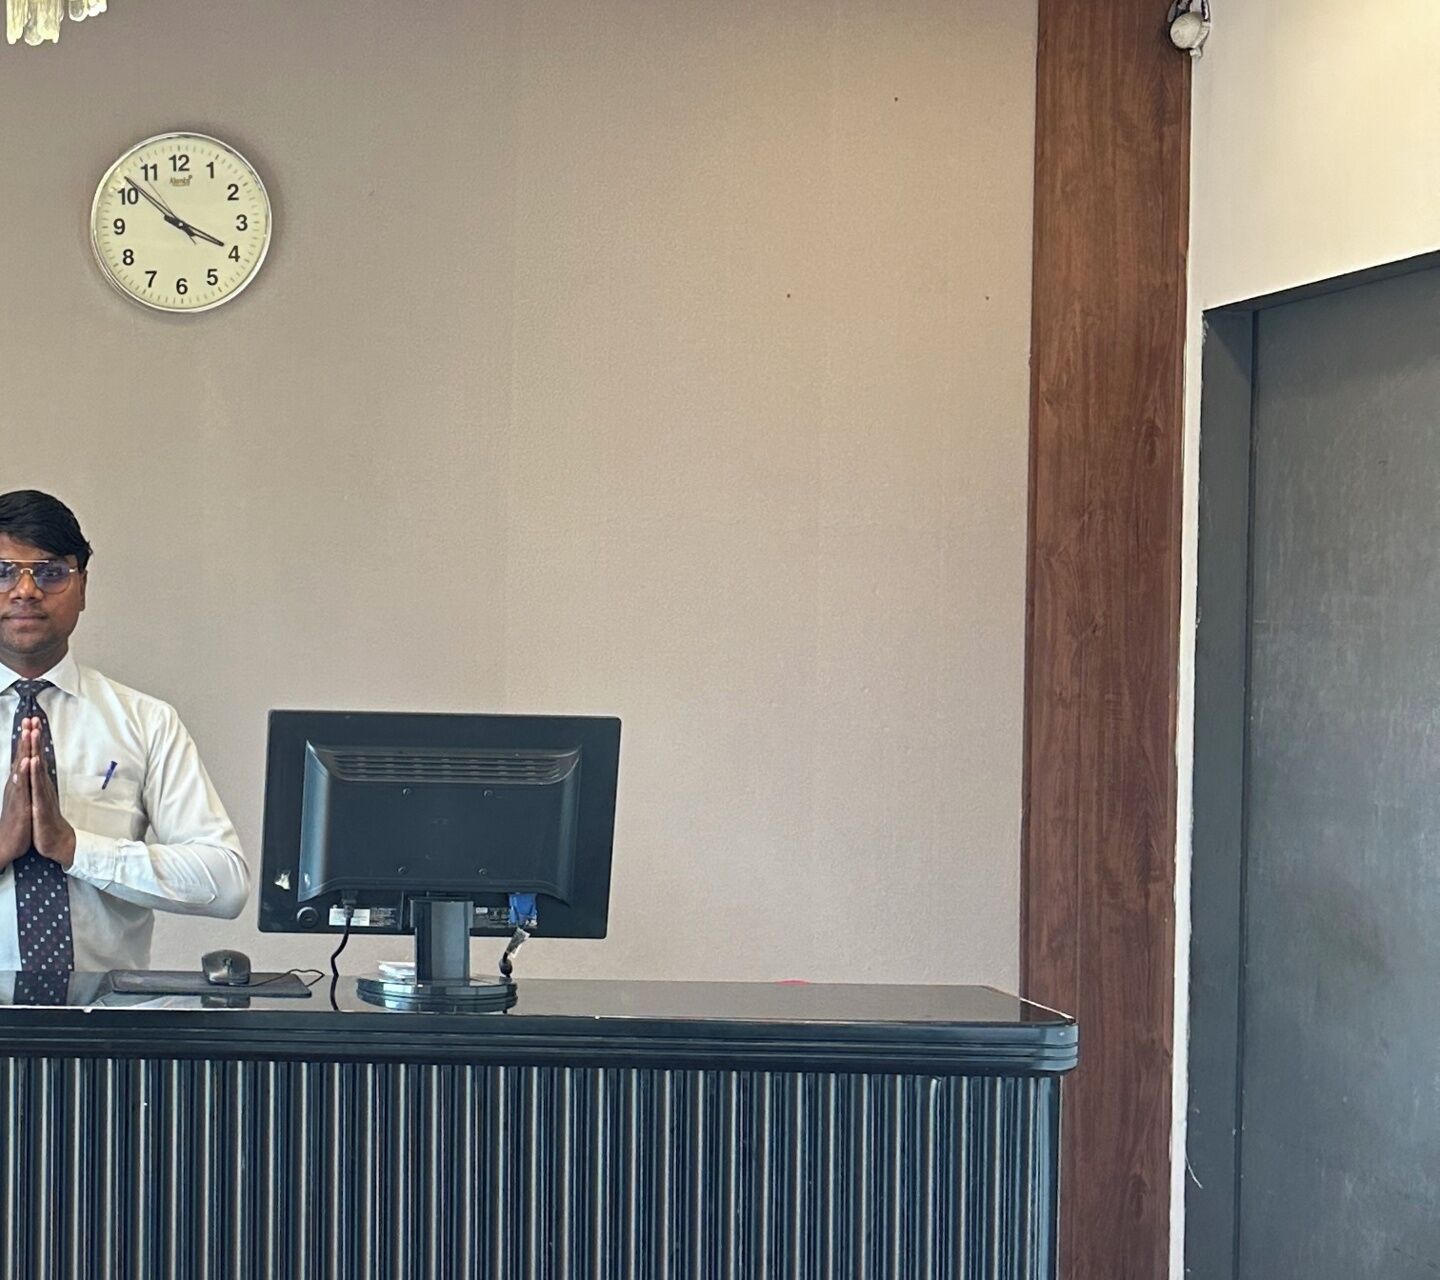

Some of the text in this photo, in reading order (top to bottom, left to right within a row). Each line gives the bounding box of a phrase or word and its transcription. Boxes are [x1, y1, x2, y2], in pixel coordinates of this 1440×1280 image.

[169, 154, 190, 172] 12
[206, 162, 215, 179] 1
[140, 163, 158, 181] 11
[118, 187, 139, 205] 10
[227, 184, 239, 201] 2
[113, 218, 126, 235] 9
[236, 214, 248, 231] 3
[122, 249, 134, 266] 8
[228, 245, 241, 262] 4
[145, 271, 157, 288] 7
[176, 278, 188, 294] 6
[206, 269, 219, 286] 5
